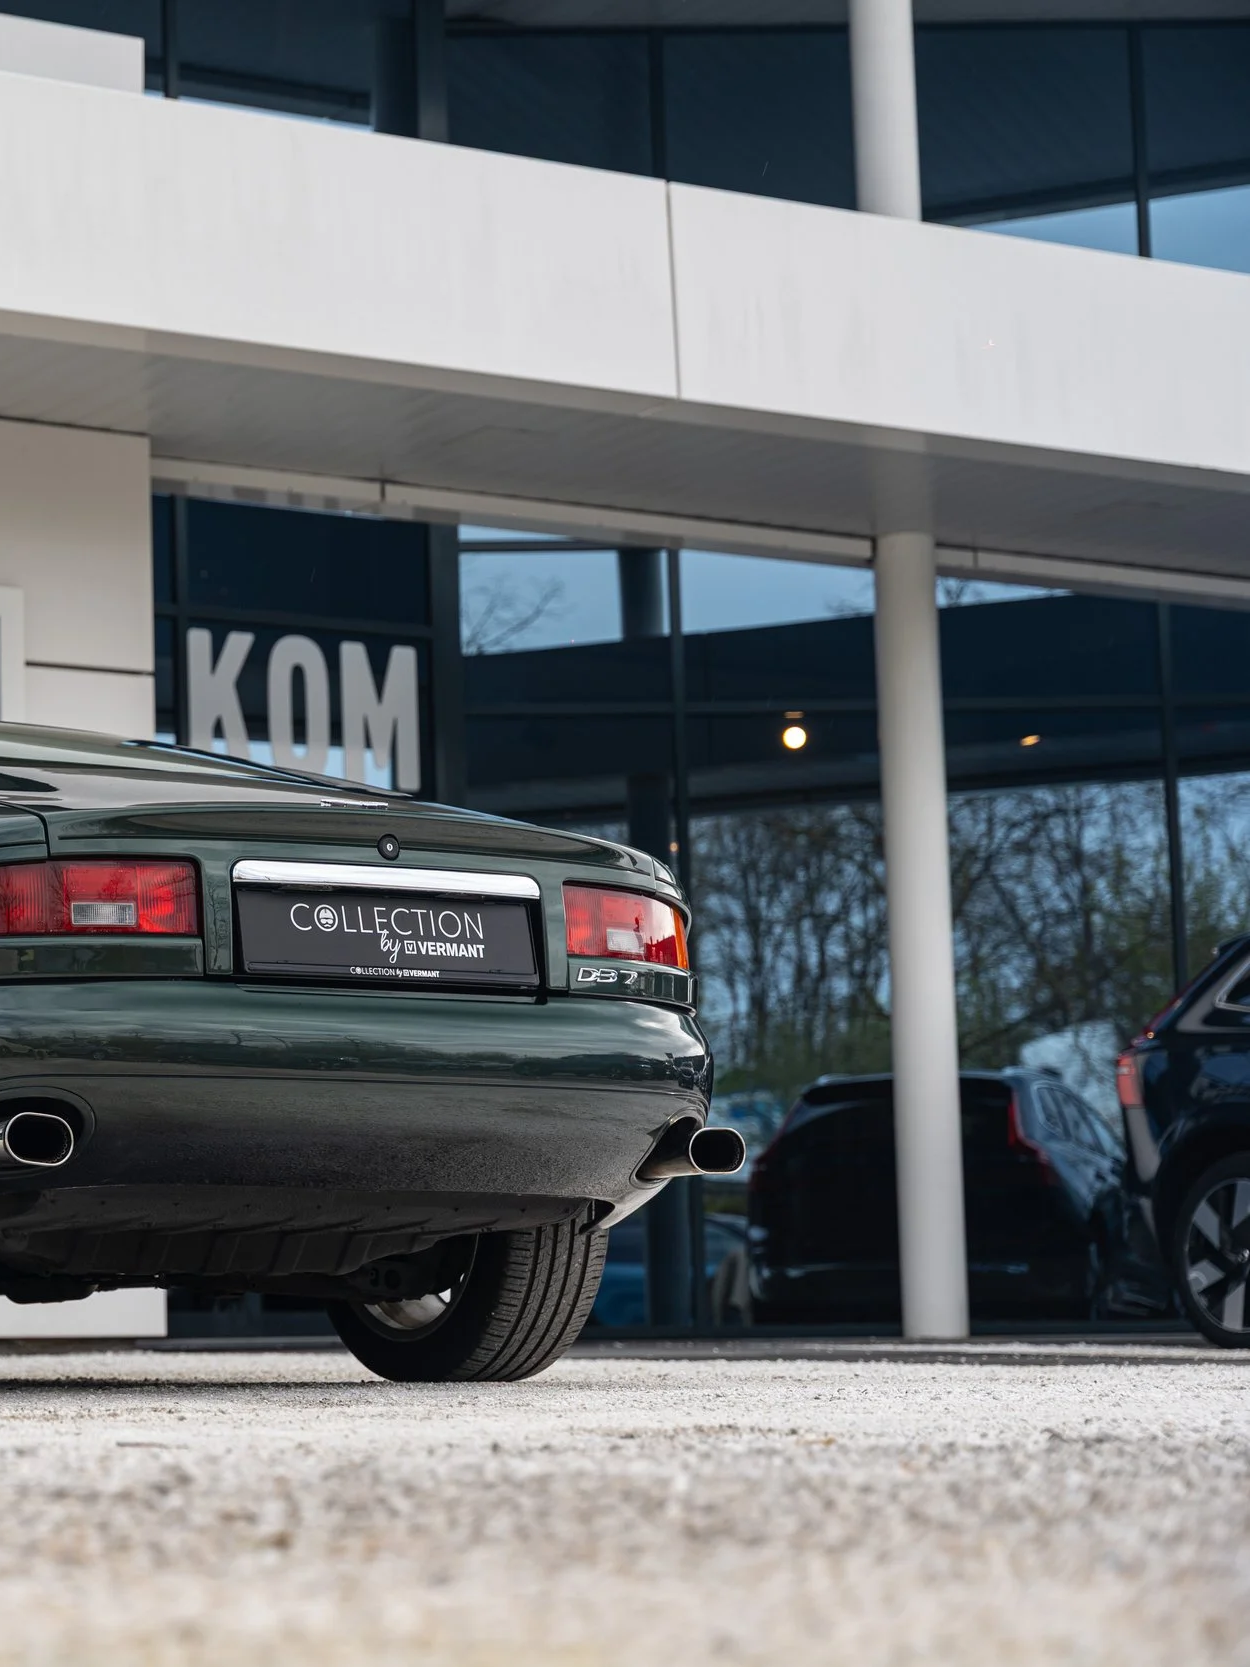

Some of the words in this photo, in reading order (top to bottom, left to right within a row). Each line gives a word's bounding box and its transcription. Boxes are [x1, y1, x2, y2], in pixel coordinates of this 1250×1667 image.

[186, 626, 421, 792] KOM
[290, 903, 484, 939] COLLECTION
[380, 929, 401, 963] by
[418, 941, 485, 958] VERMANT
[350, 966, 395, 976] COLLECTION
[410, 969, 440, 978] VERMANT
[576, 967, 638, 985] DB7
